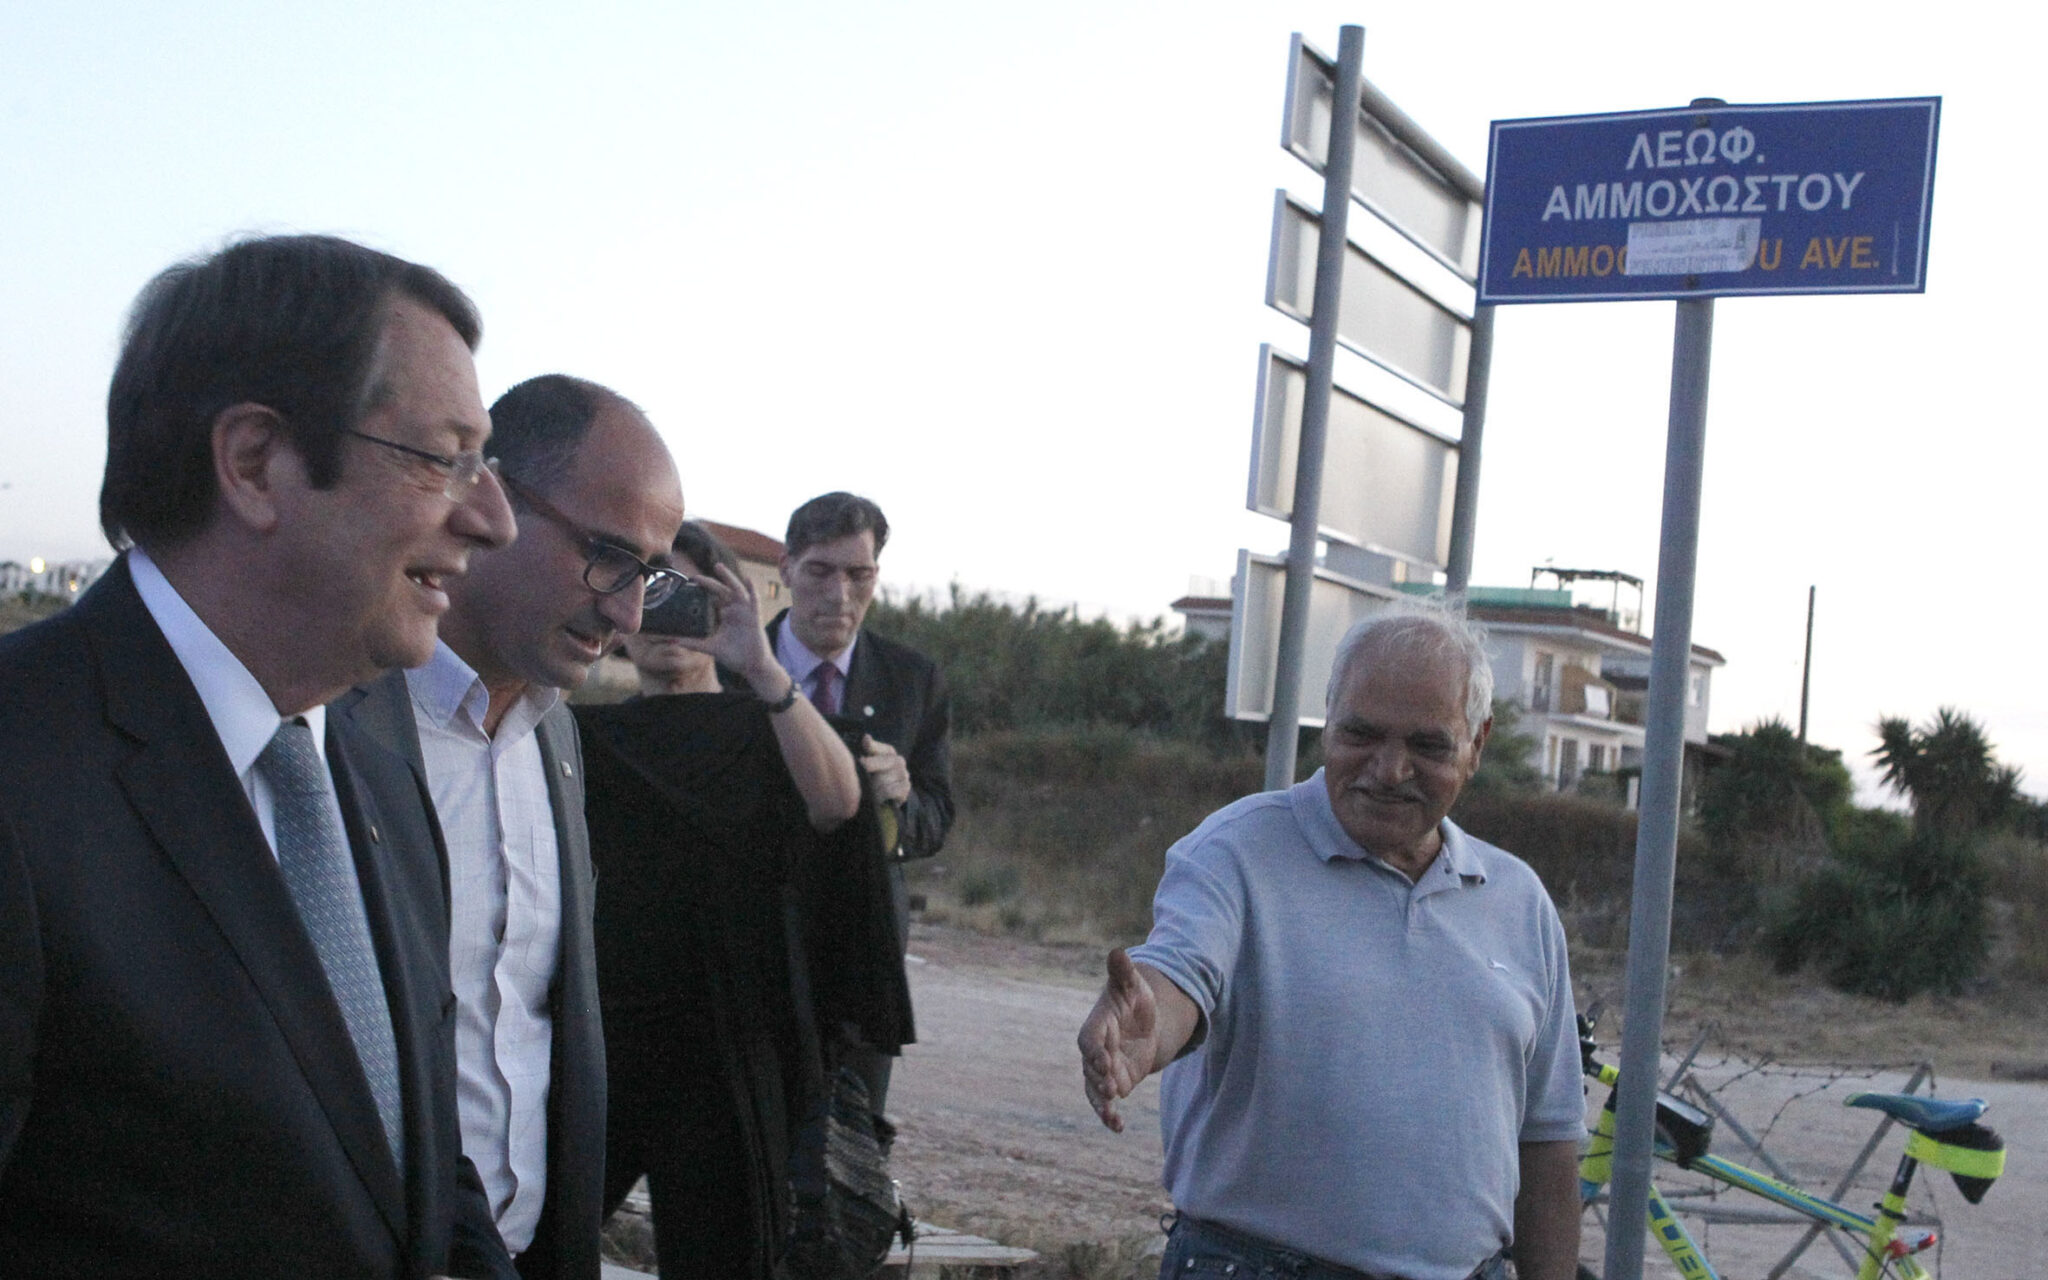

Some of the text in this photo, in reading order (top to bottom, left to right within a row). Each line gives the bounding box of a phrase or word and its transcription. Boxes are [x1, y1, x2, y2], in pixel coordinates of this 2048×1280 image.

[1626, 126, 1765, 170] ΛΕΩΦ.
[1541, 172, 1865, 222] ΑΜΜΟΧΩΣΤΟΥ
[1799, 236, 1880, 270] AVE.
